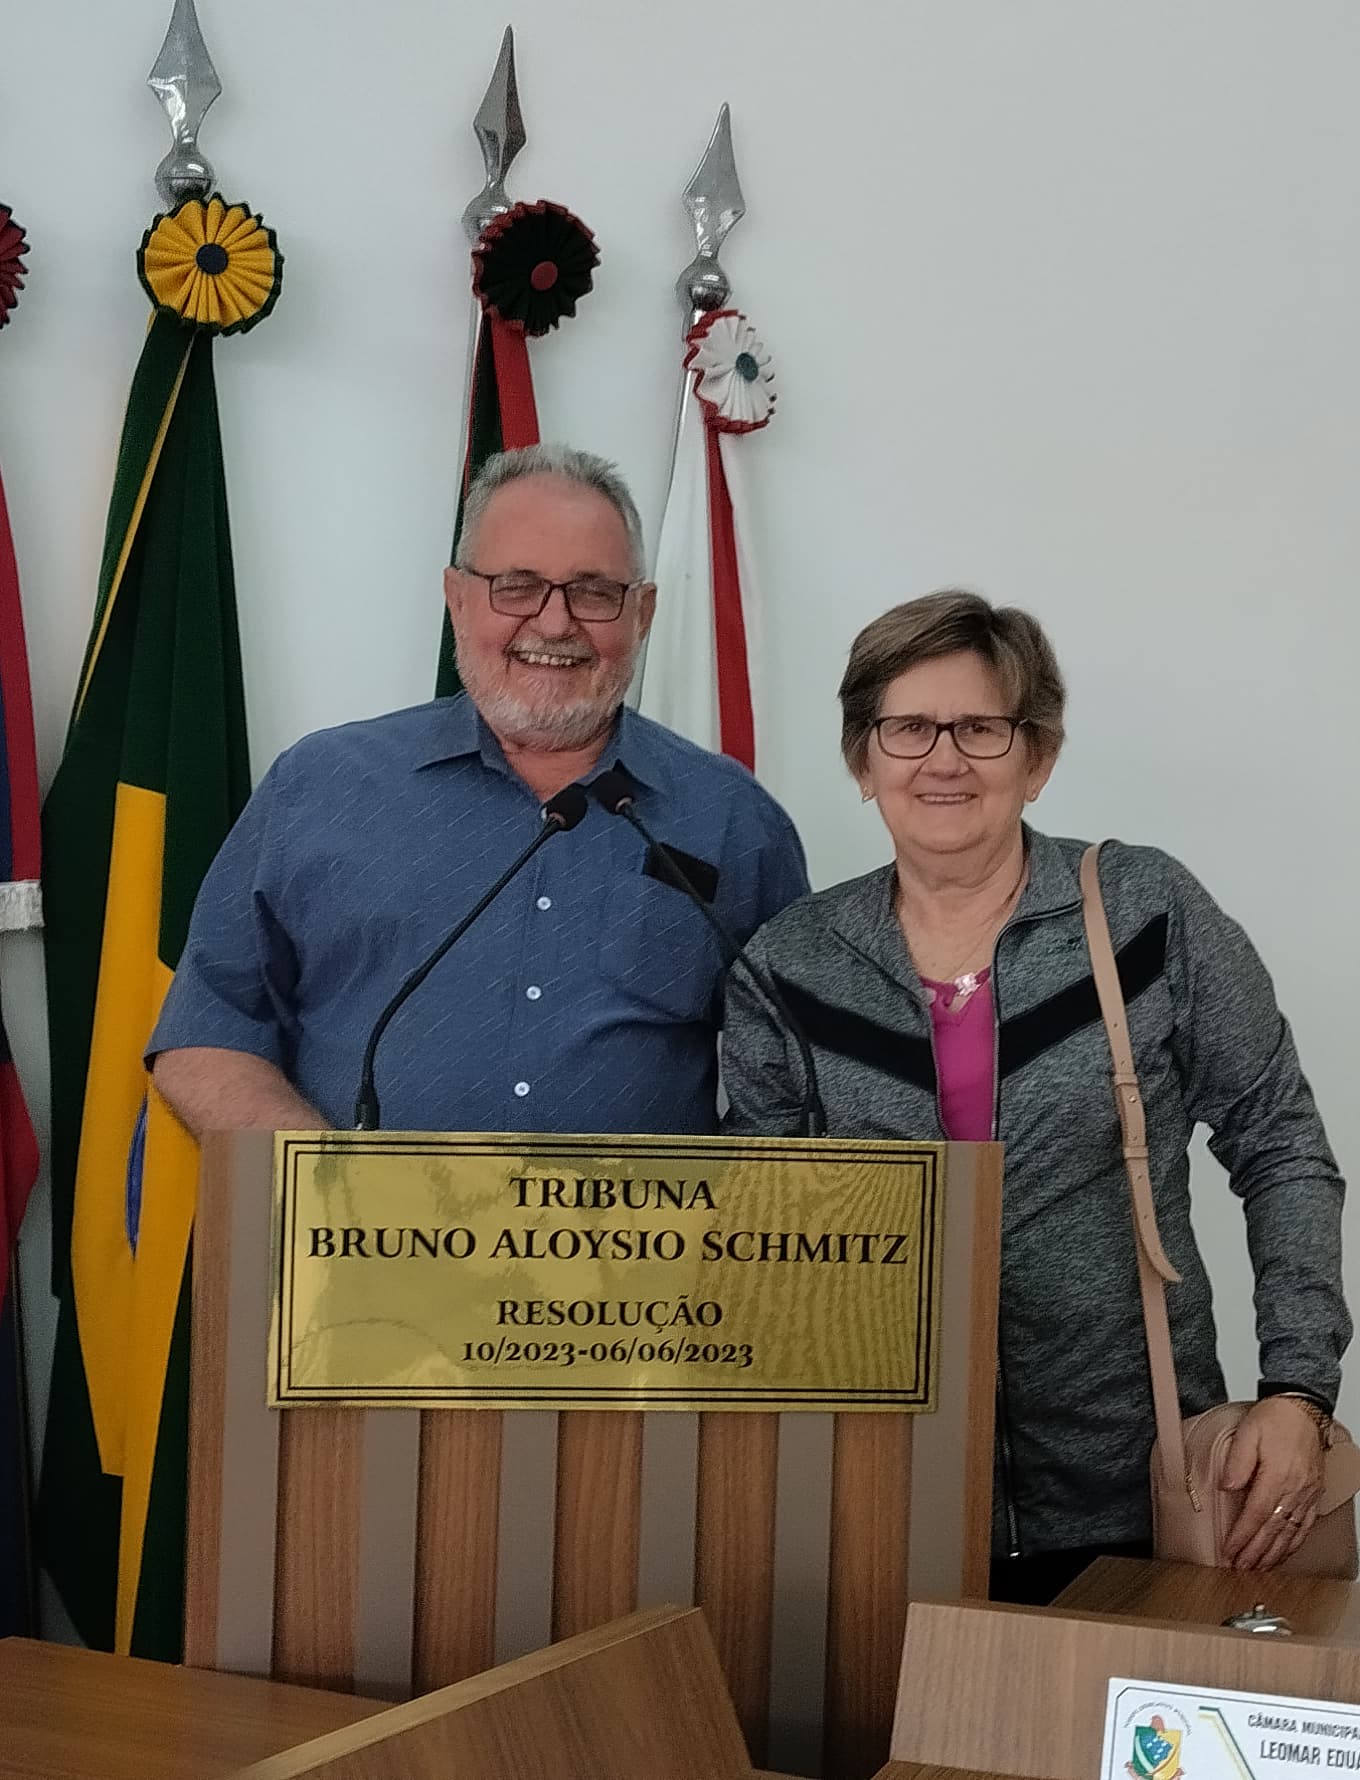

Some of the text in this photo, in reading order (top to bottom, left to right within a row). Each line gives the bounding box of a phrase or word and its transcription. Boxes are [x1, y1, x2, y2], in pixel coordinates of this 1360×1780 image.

[509, 1176, 717, 1210] TRIBUNA
[309, 1227, 910, 1265] BRUNO ALOYSIO SCHMITZ
[497, 1295, 723, 1334] RESOLUÇÃO
[463, 1336, 754, 1368] 10/2023-06/06/2023
[1259, 1740, 1321, 1766] LEOMAR
